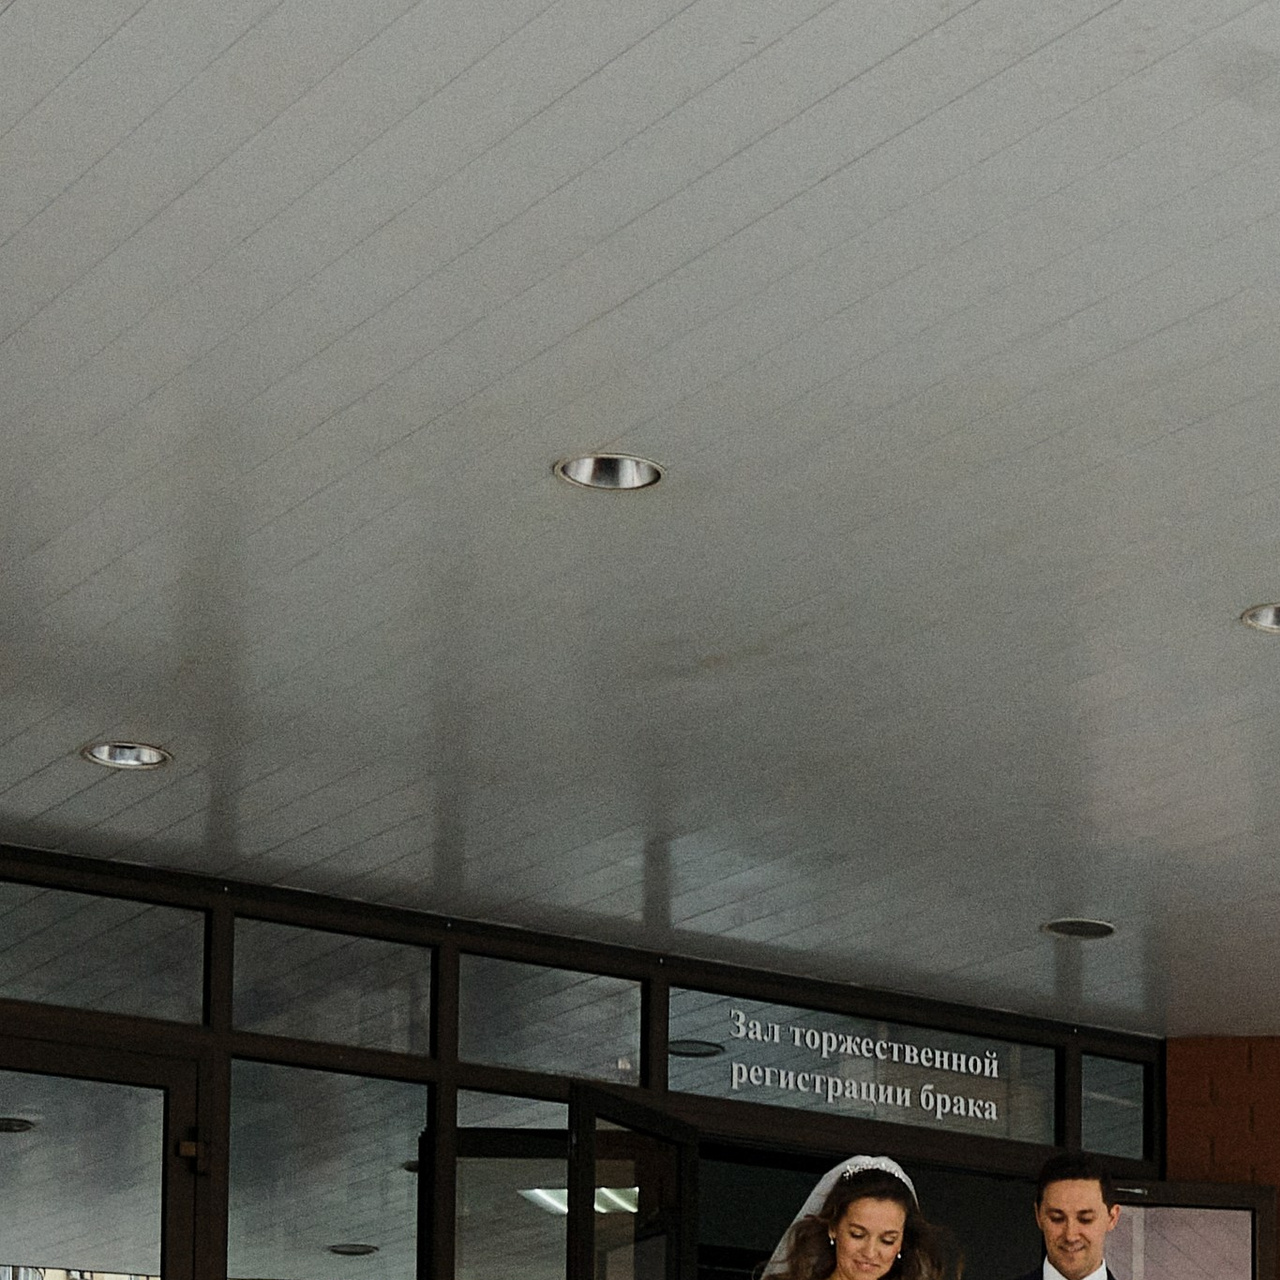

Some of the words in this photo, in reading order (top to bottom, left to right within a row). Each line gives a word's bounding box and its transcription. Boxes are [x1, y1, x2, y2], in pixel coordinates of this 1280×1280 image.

[729, 1009, 780, 1044] Зал
[789, 1024, 1000, 1078] торжественной
[731, 1062, 911, 1108] регистрации
[920, 1084, 998, 1121] брака
